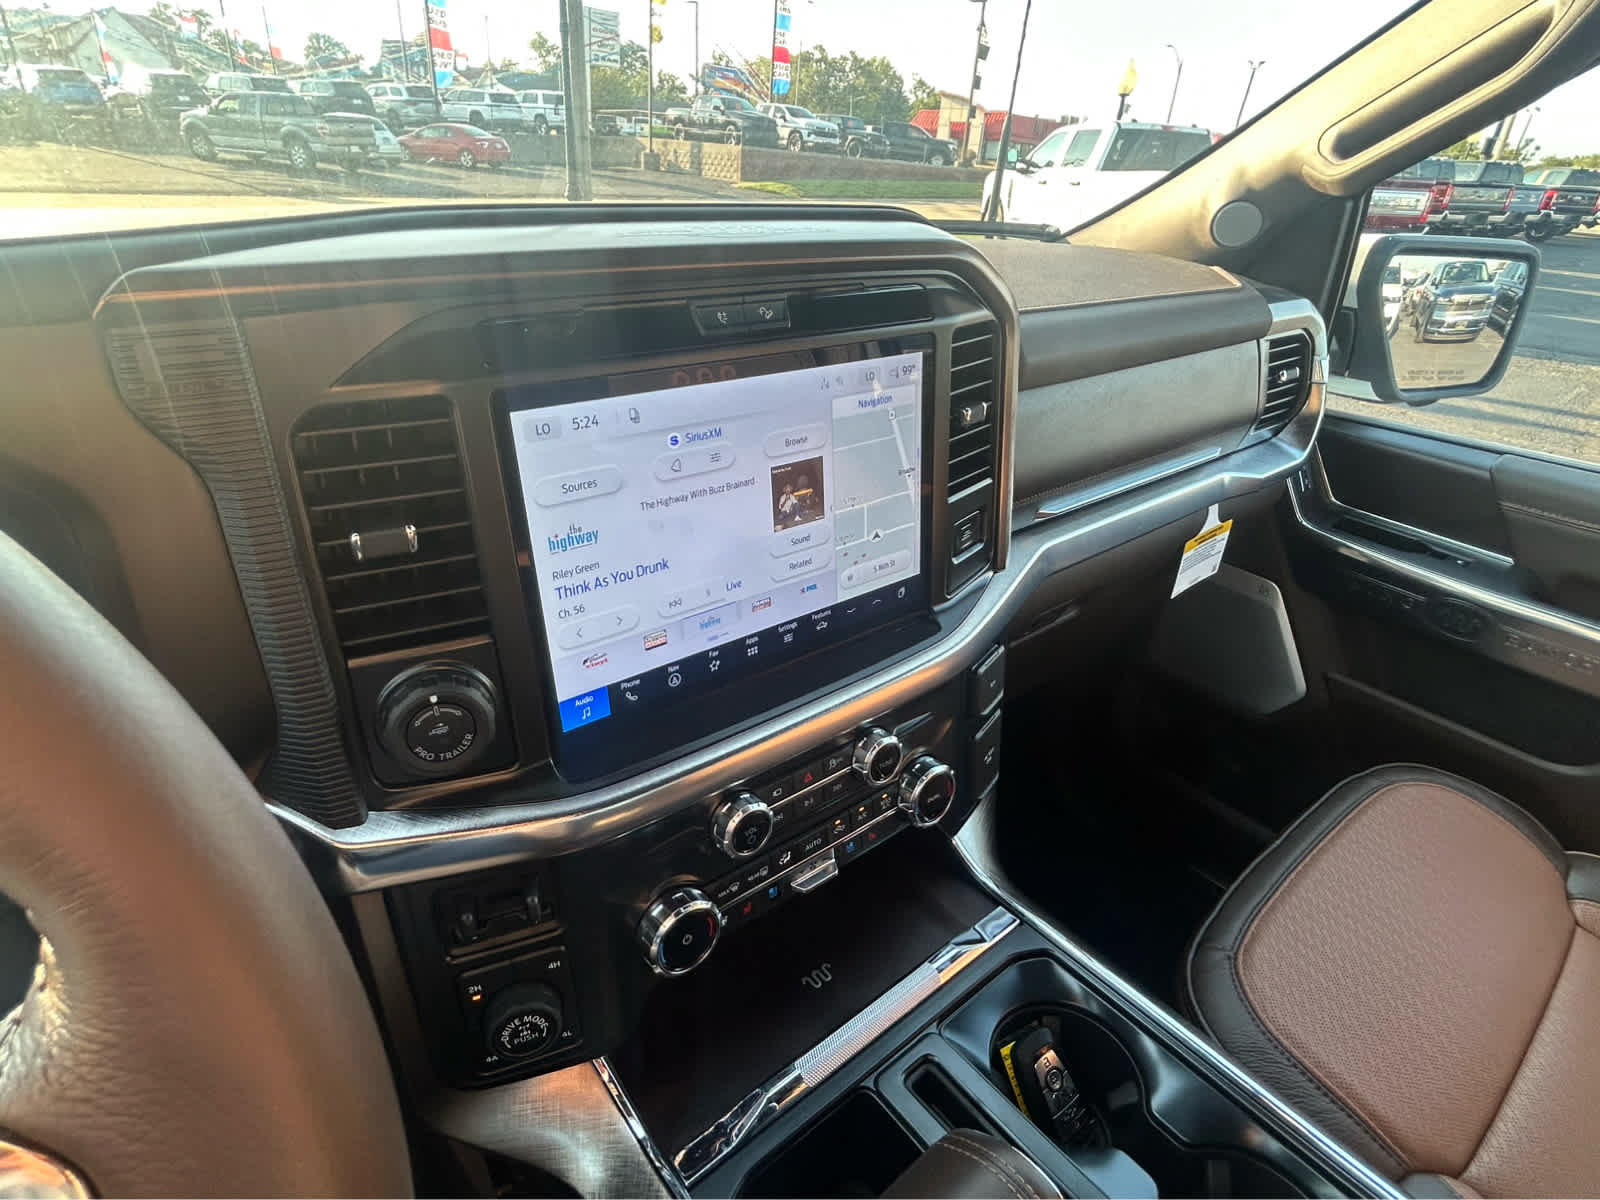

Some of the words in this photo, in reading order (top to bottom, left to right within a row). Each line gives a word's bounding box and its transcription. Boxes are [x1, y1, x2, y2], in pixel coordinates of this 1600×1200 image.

[858, 394, 893, 409] Navigation
[535, 423, 550, 436] LO
[572, 414, 599, 431] 5:24
[685, 427, 722, 443] SiriusXM
[785, 436, 808, 447] Browse
[561, 478, 598, 494] Sources
[640, 501, 656, 511] The
[656, 494, 689, 508] Highway
[689, 488, 708, 499] With
[708, 484, 725, 496] Buzz
[725, 477, 755, 492] Brainard
[569, 523, 582, 534] the
[548, 529, 599, 552] highway
[791, 534, 811, 546] Sound
[552, 567, 574, 581] Riley
[575, 561, 600, 575] Green
[789, 557, 812, 571] Related
[554, 582, 591, 600] Think
[594, 576, 609, 590] As
[611, 570, 634, 585] You
[636, 558, 669, 578] Drunk
[726, 579, 742, 592] Live
[558, 607, 572, 619] Ch.
[573, 604, 585, 614] 56
[620, 678, 640, 690] Phone
[575, 695, 594, 707] Audio
[414, 746, 435, 760] PRO
[440, 732, 474, 760] TRAILER
[805, 838, 822, 850] AUTO
[501, 1018, 521, 1041] DRIVE
[523, 1015, 549, 1029] MODE
